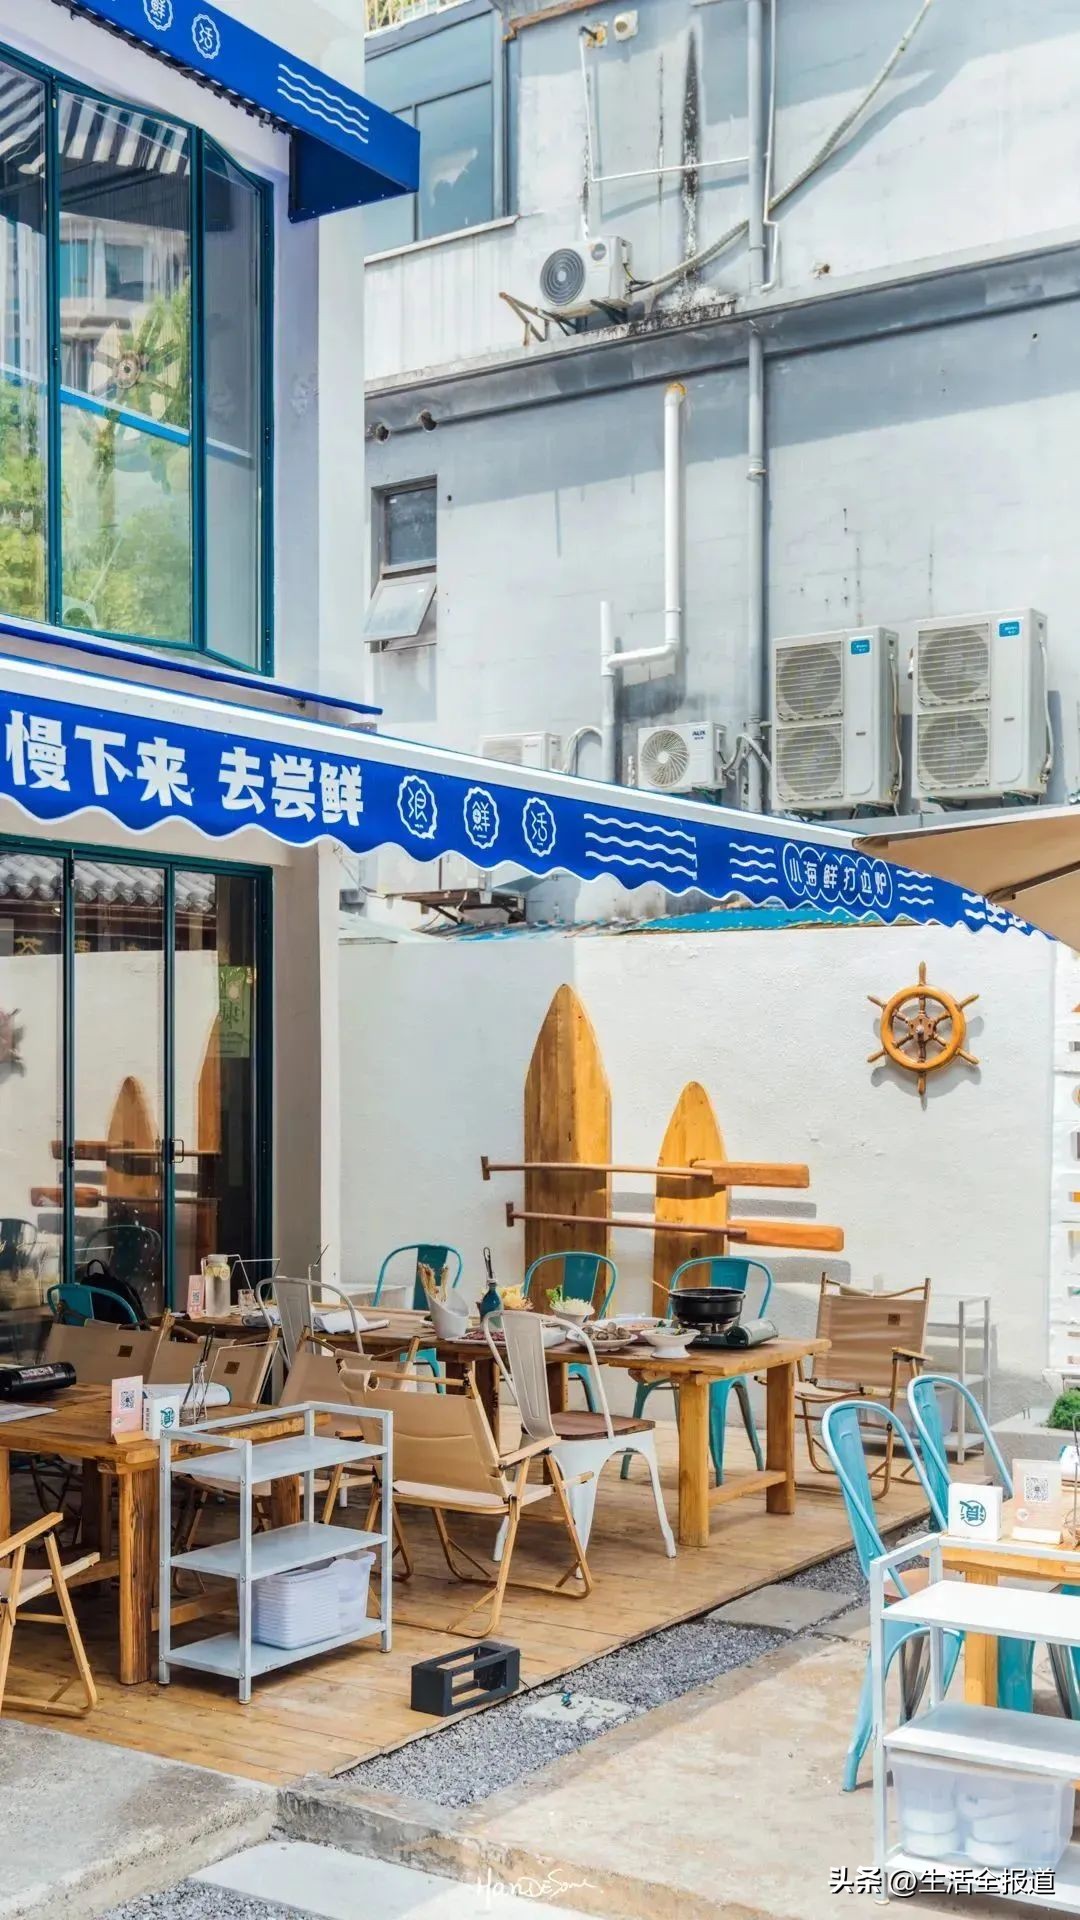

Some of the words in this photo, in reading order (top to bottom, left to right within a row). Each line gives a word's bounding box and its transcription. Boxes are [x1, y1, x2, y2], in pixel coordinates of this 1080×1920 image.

[5, 710, 194, 807] 慢下来
[218, 746, 365, 827] 去尝鲜
[789, 857, 887, 895] 小海鲜打边炉
